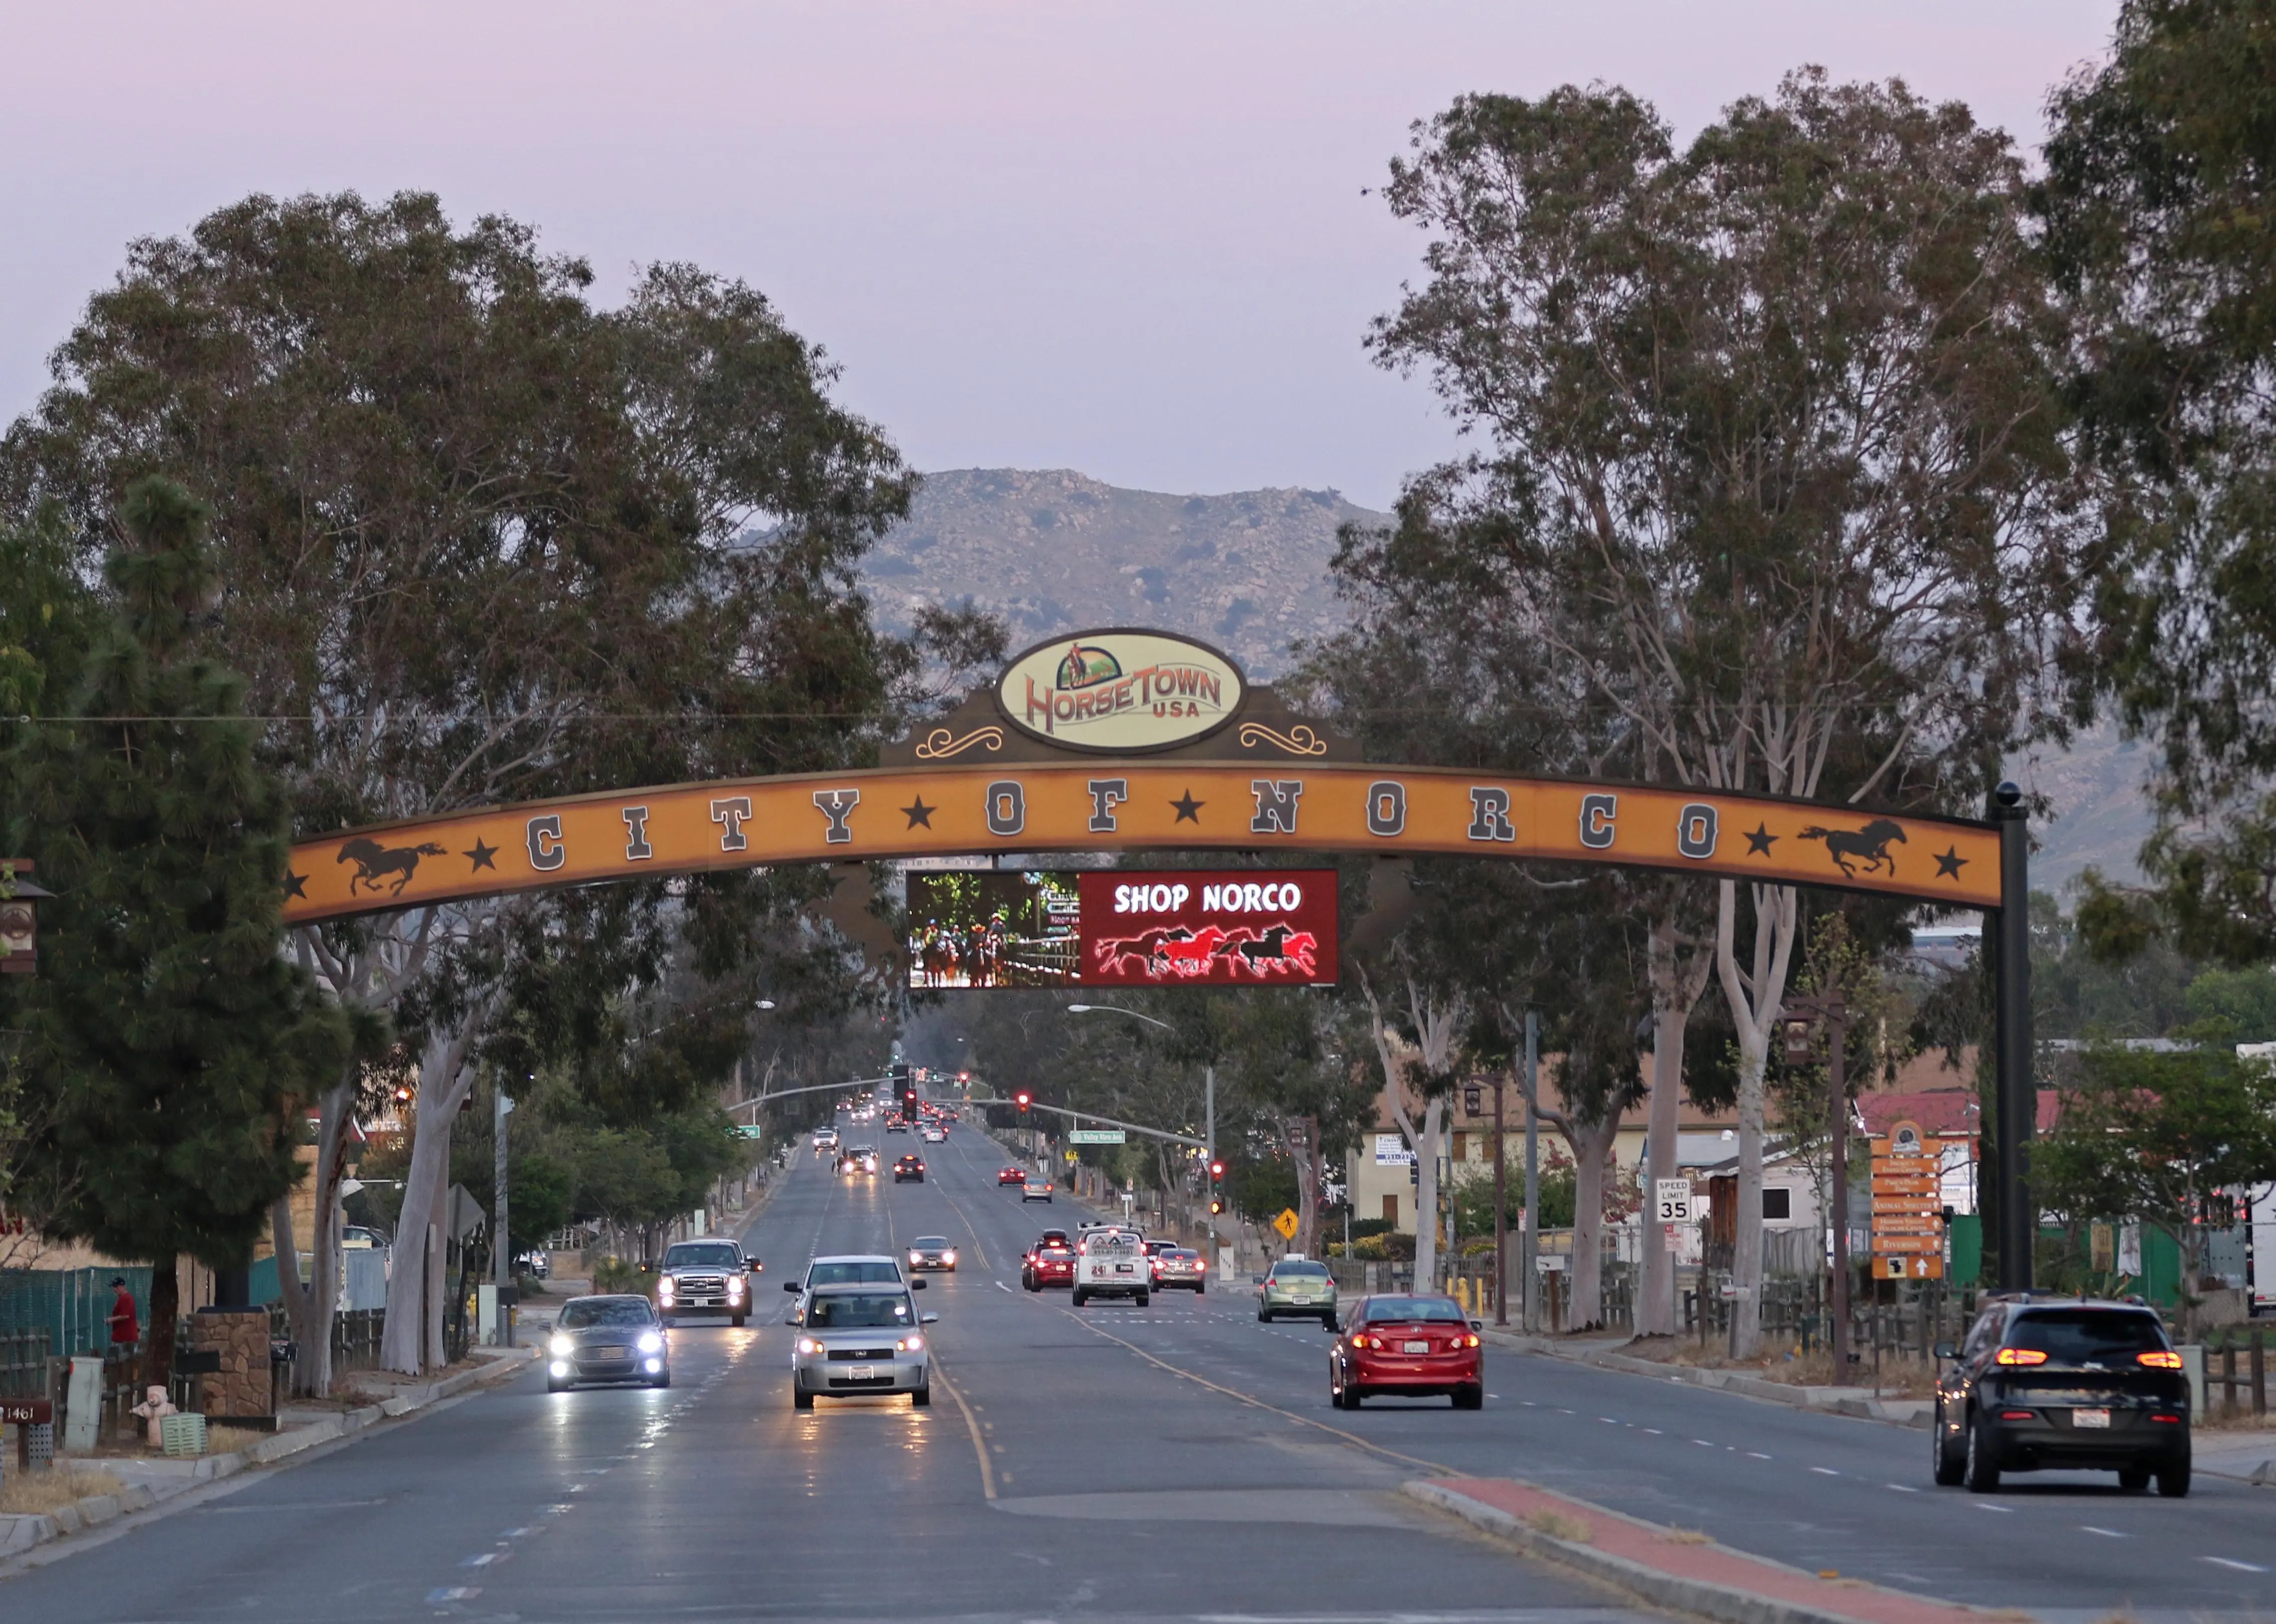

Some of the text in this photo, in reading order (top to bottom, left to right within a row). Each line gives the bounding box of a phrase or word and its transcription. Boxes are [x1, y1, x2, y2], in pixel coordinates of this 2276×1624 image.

[1154, 701, 1199, 718] USA
[526, 779, 1719, 871] CITY OF NORCO
[1113, 882, 1303, 914] SHOP NORCO
[1661, 1202, 1687, 1217] 35
[8, 1407, 34, 1419] 1461
